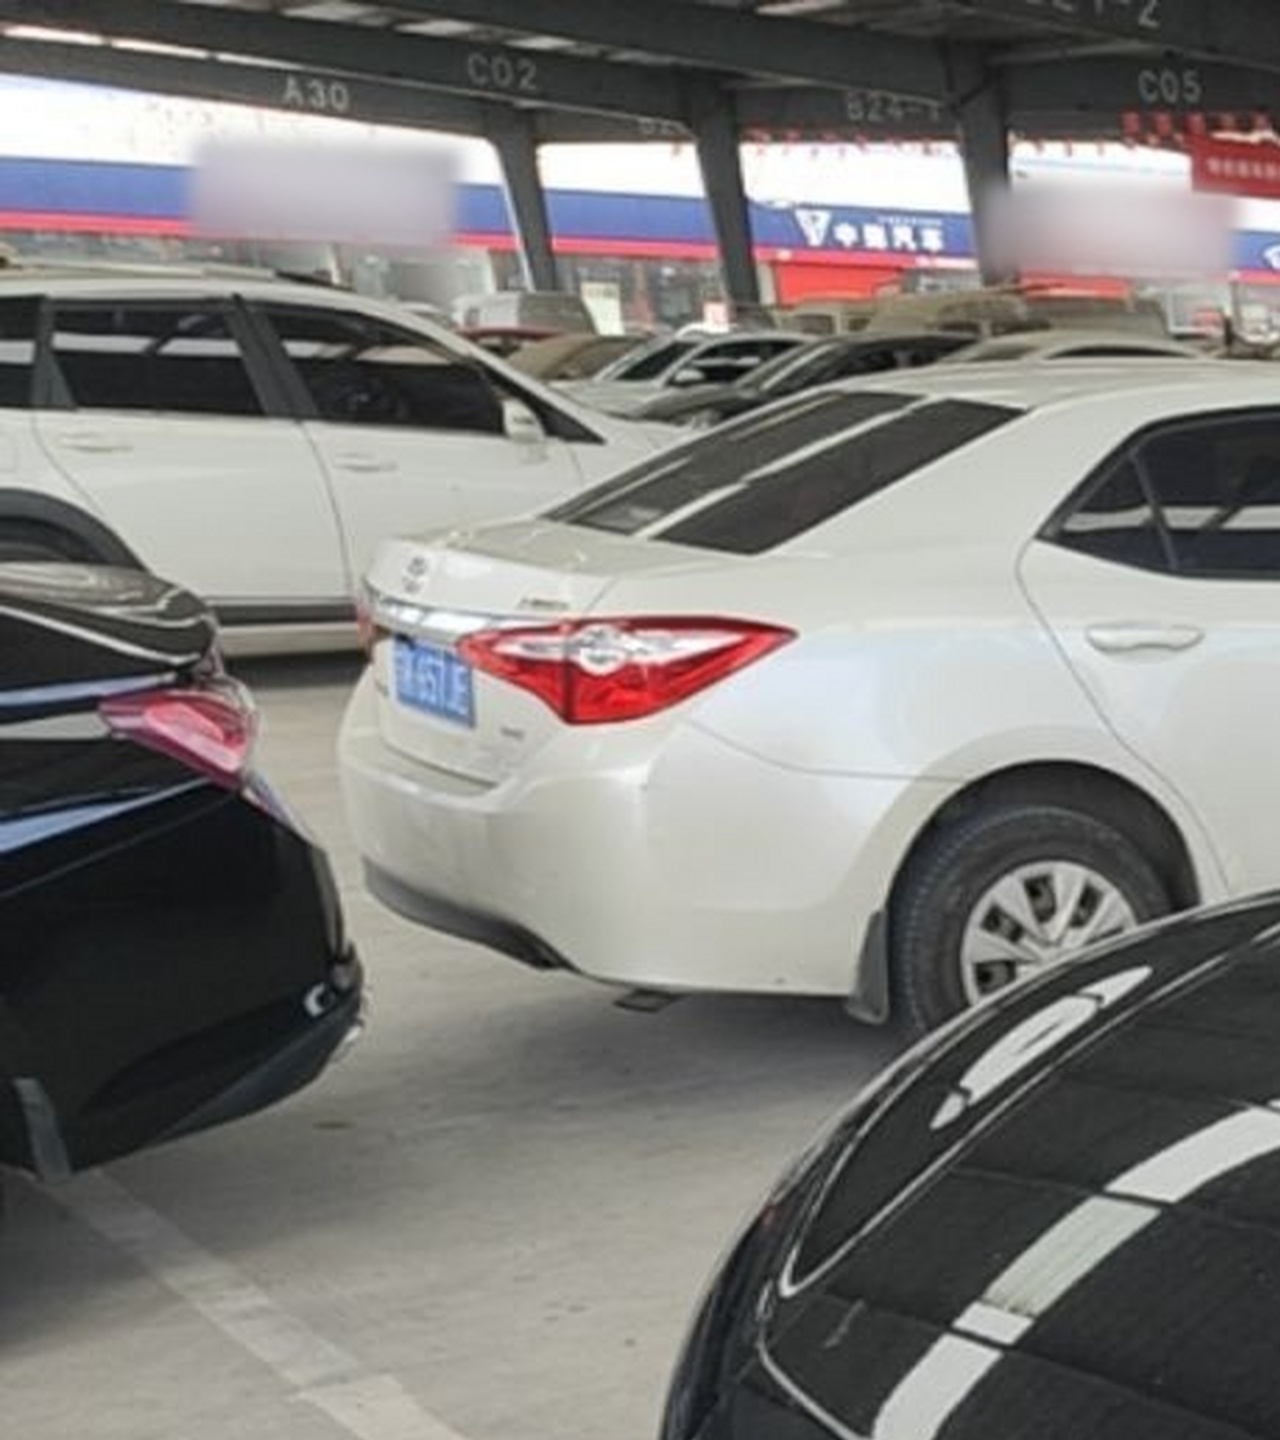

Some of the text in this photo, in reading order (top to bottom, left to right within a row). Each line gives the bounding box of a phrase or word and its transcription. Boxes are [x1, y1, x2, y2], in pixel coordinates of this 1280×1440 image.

[467, 52, 537, 91] C02
[1138, 69, 1201, 103] C05
[283, 74, 350, 112] A30
